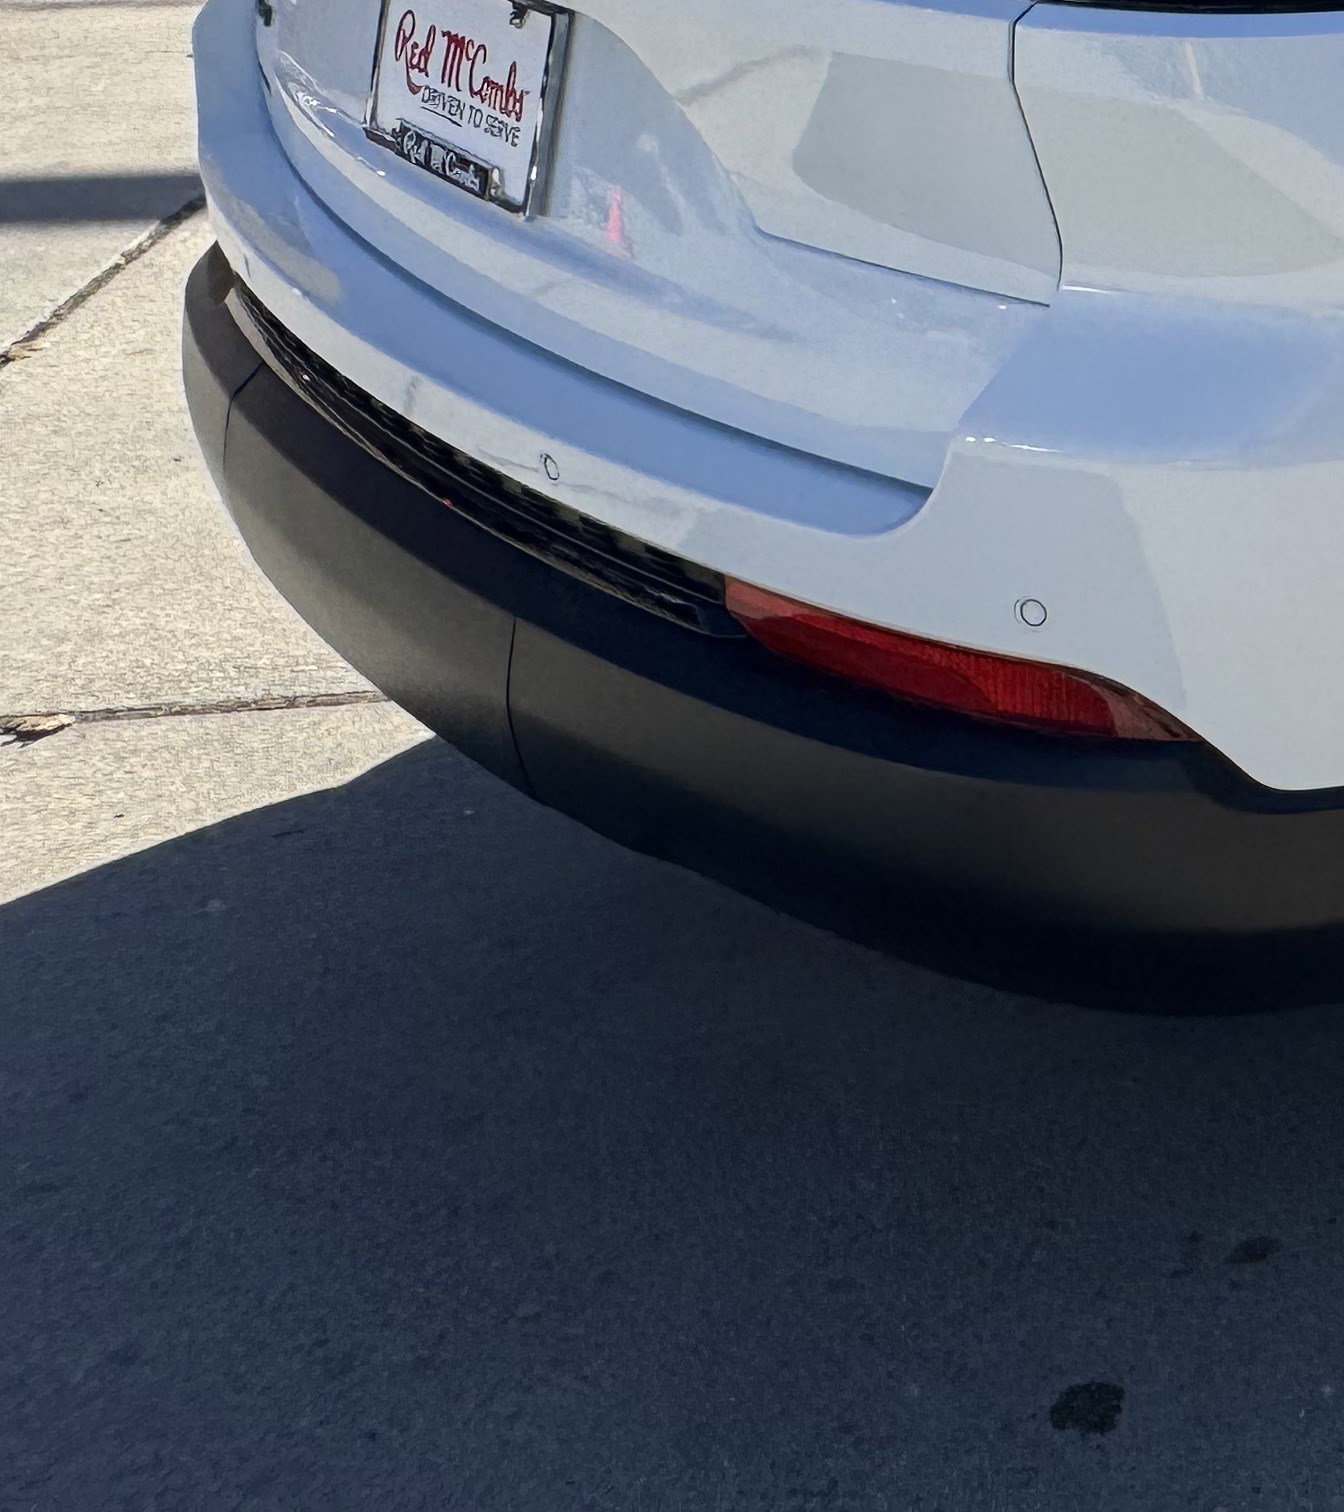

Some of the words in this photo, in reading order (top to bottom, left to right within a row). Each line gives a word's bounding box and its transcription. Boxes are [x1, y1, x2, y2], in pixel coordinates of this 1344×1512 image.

[394, 9, 437, 95] Red
[441, 29, 526, 123] McCombs
[467, 103, 483, 129] TO
